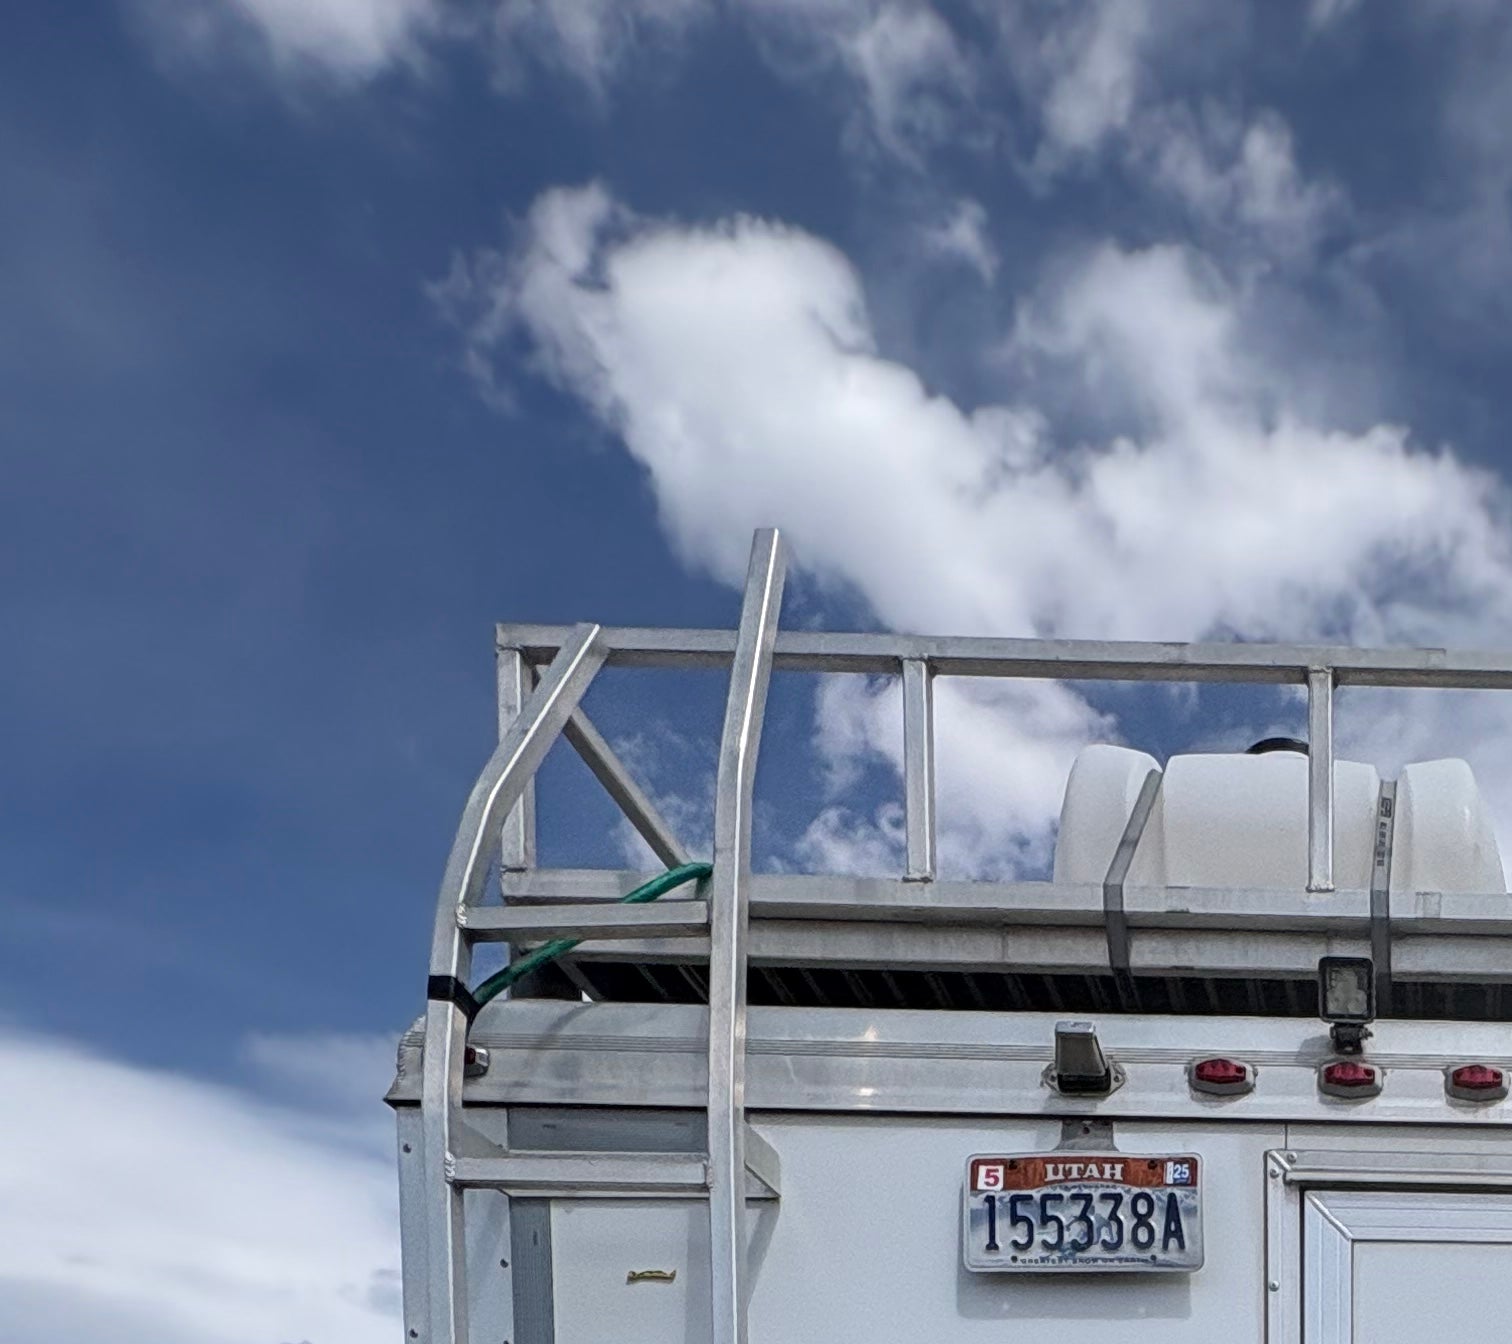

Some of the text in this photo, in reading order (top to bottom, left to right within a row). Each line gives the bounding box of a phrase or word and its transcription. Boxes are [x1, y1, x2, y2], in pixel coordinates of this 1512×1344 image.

[983, 1167, 1000, 1187] 5
[1044, 1163, 1124, 1182] UTAH
[1173, 1163, 1190, 1179] 25
[982, 1191, 1186, 1252] 155338A
